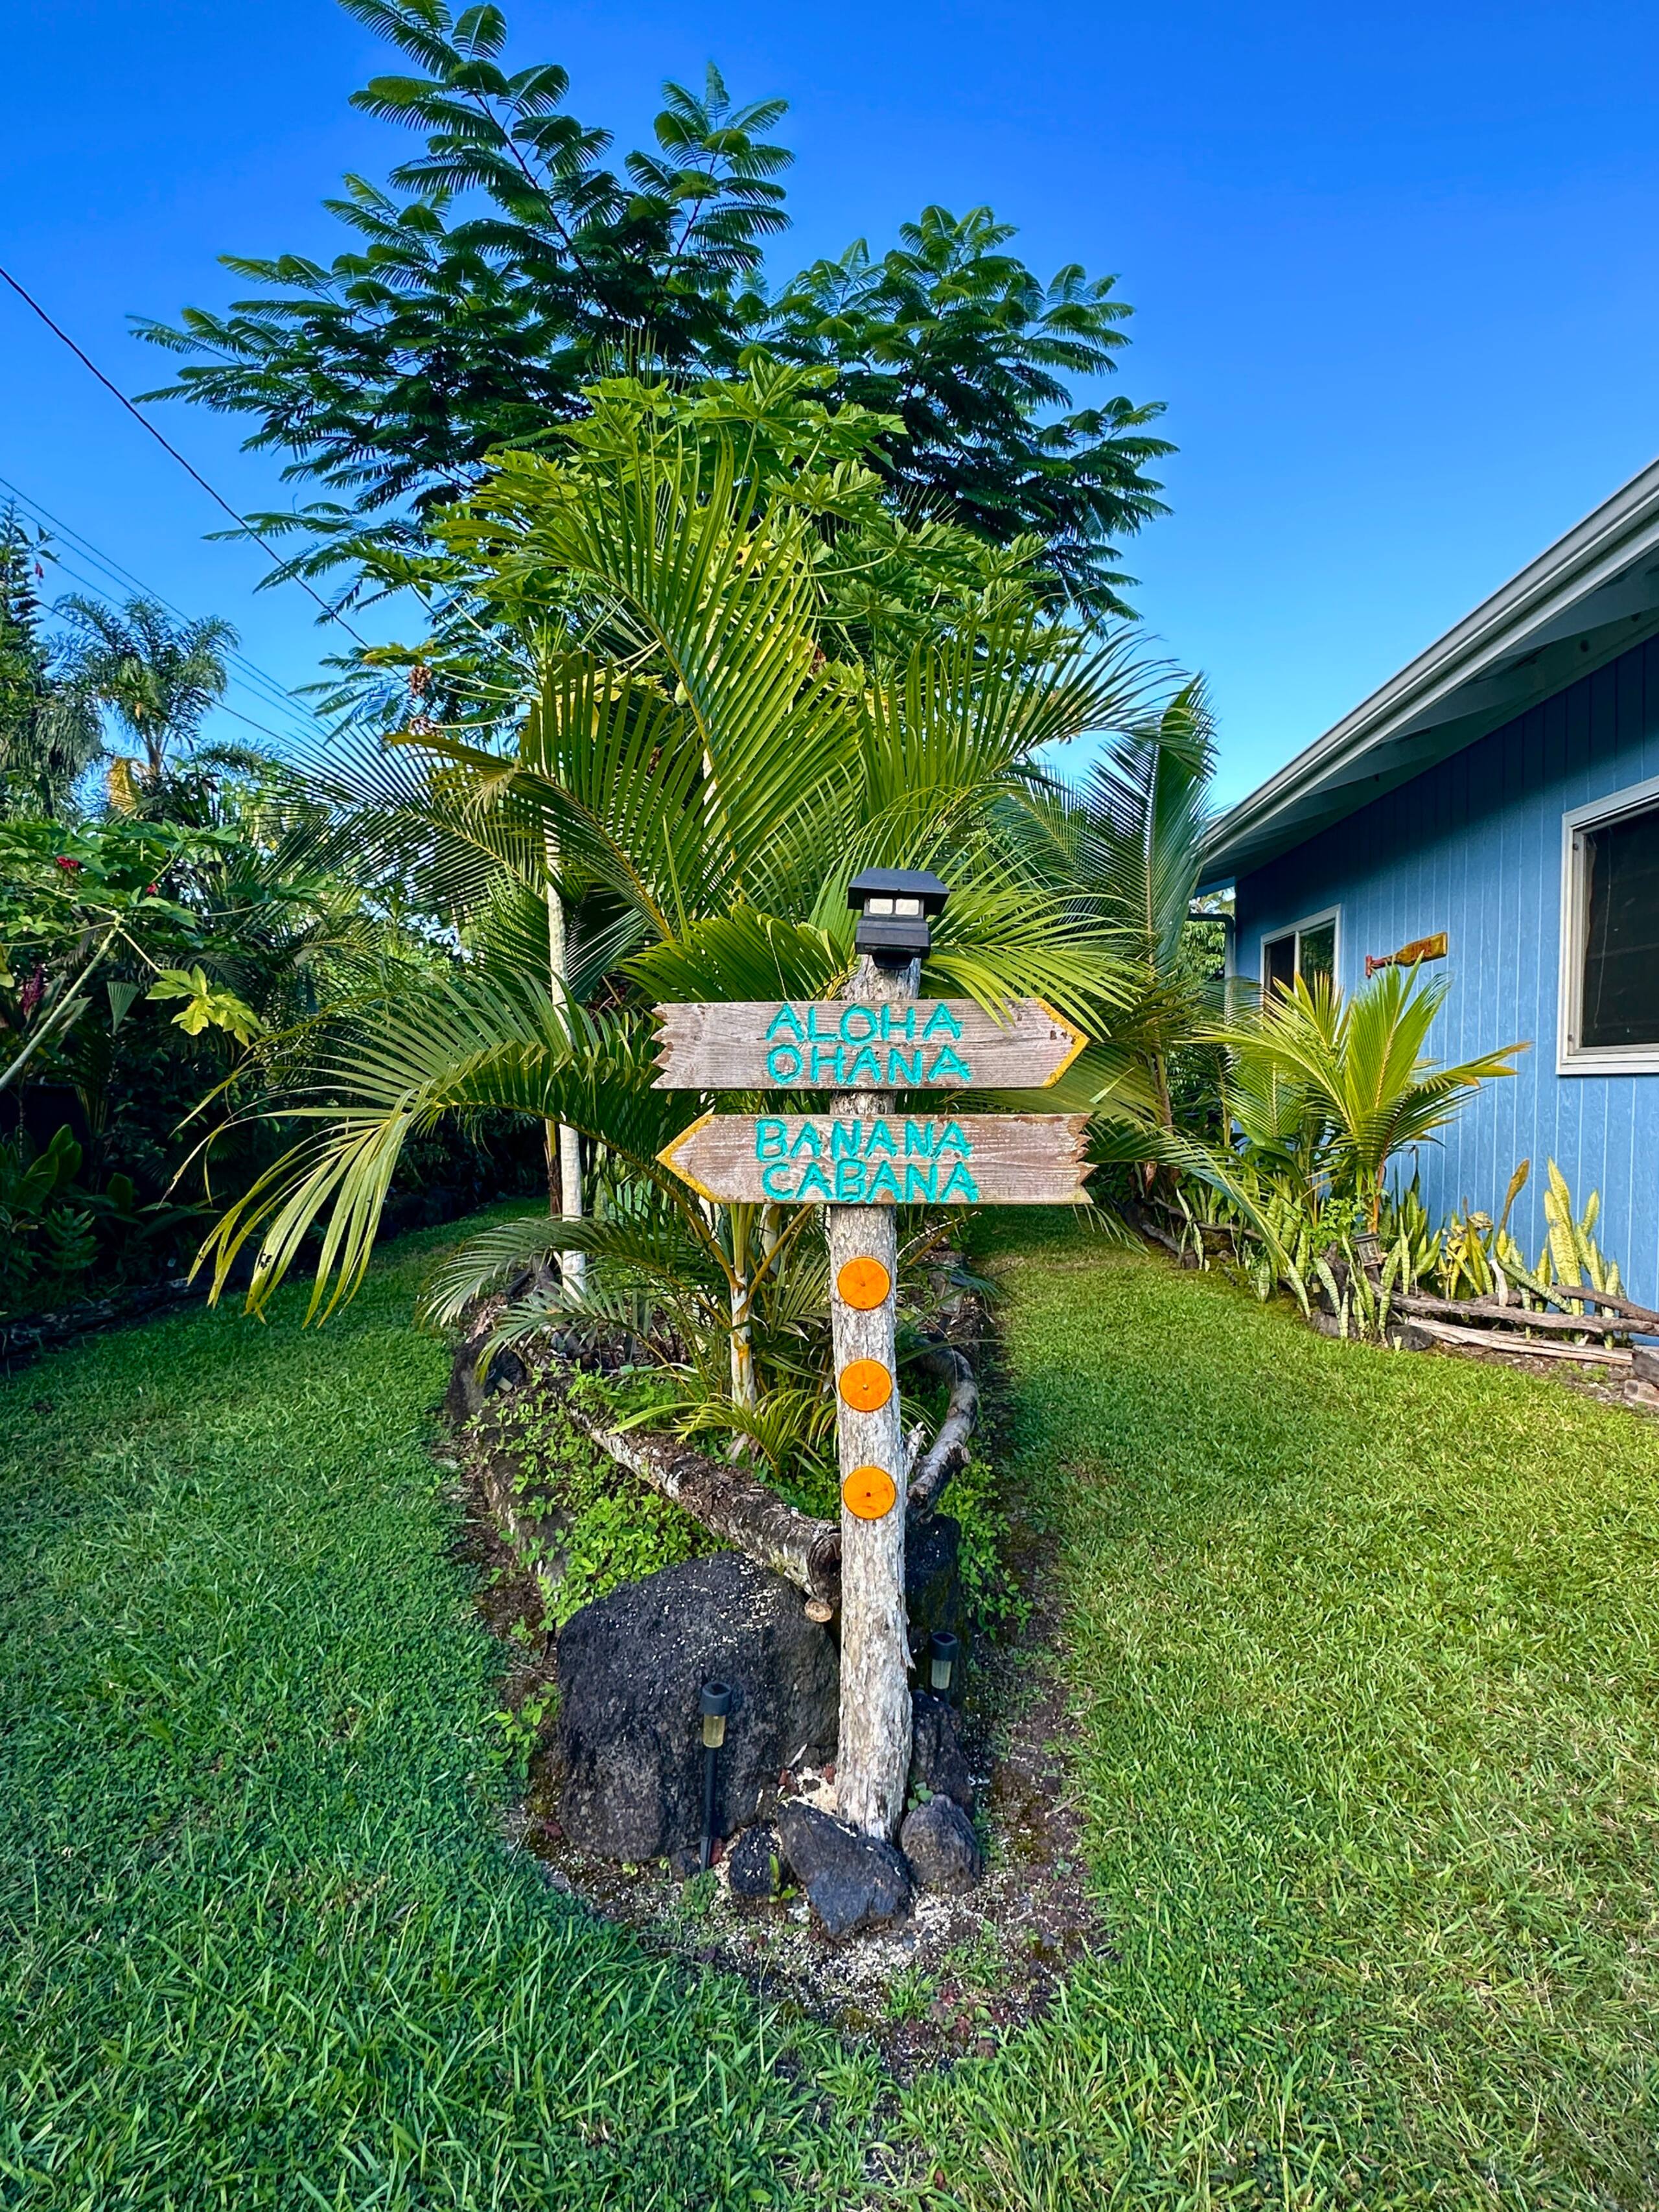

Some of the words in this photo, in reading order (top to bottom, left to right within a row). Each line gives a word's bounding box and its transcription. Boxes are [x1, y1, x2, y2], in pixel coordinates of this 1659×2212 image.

[765, 1003, 964, 1046] ALOHA
[765, 1043, 972, 1085] OHANA
[754, 1119, 972, 1162] BANANA
[761, 1157, 979, 1204] CABANA
